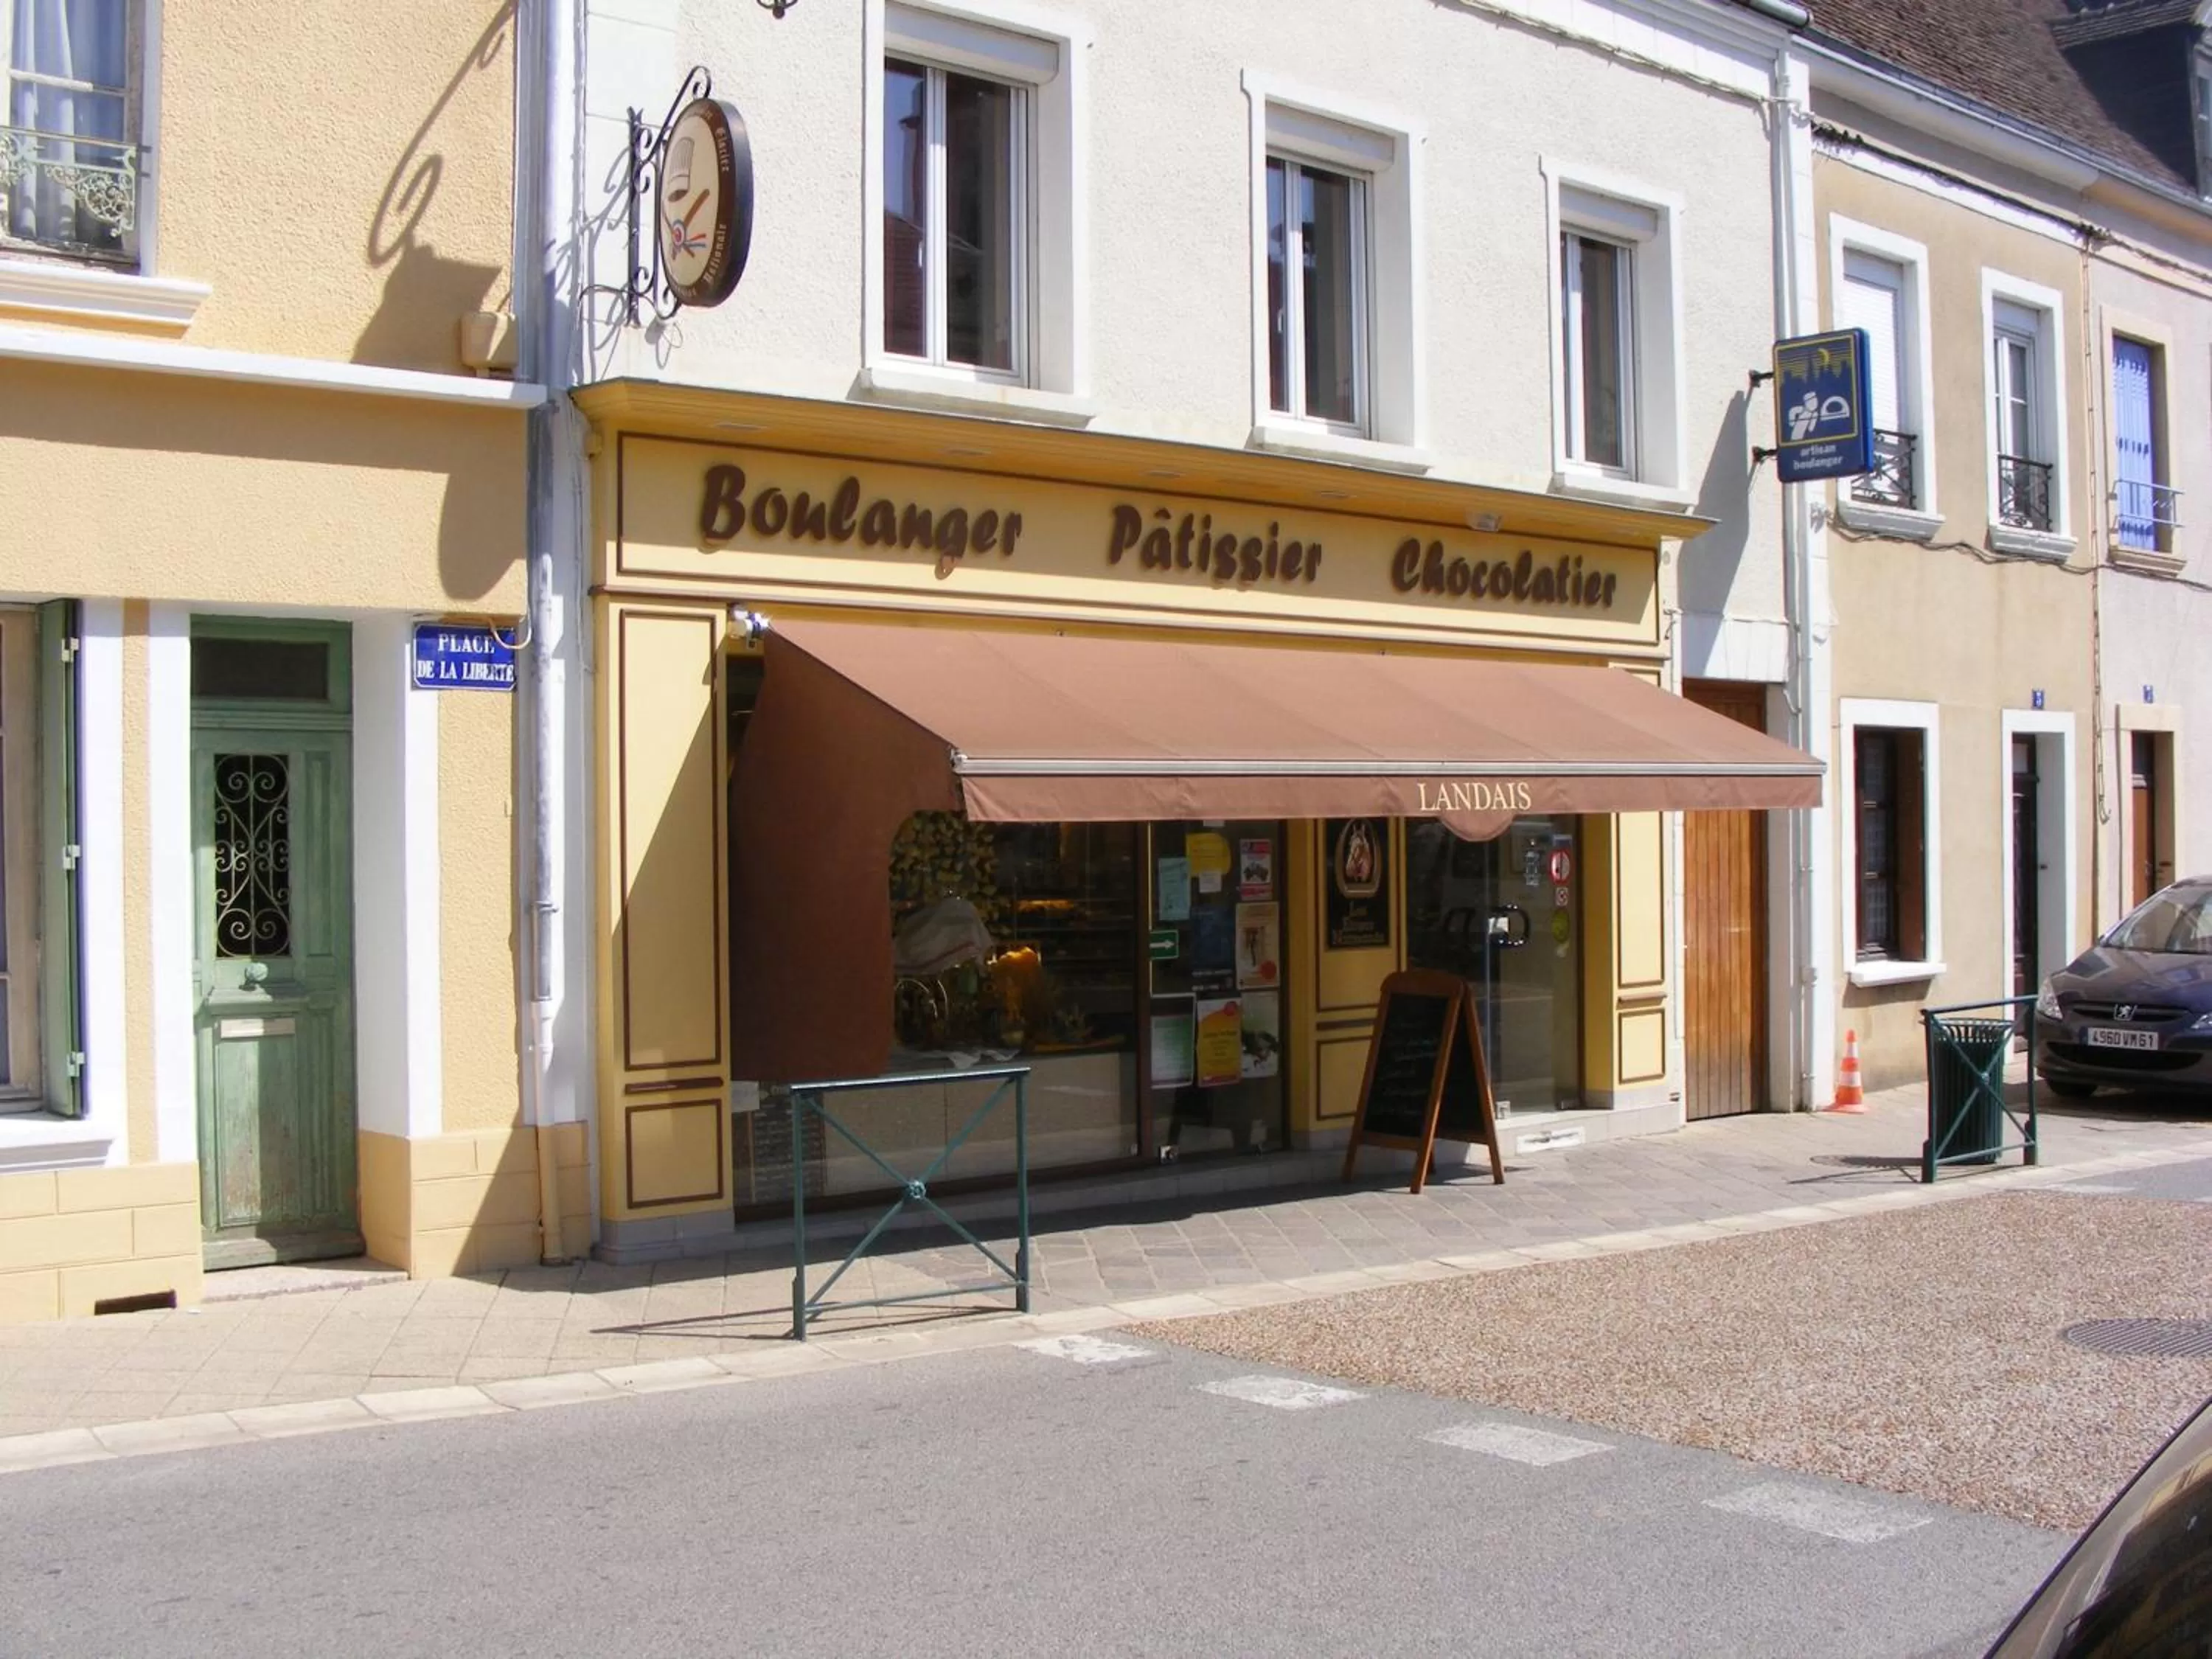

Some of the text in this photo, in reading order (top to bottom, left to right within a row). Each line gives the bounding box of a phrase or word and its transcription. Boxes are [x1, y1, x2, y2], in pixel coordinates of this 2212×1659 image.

[1800, 445, 1837, 456] artisan
[1792, 455, 1843, 470] boulanger
[700, 464, 1617, 608] Boulanger Pâtissier Chocolatier
[437, 633, 495, 654] PLACE
[417, 660, 435, 678] DE
[439, 660, 458, 679] LA
[1417, 782, 1531, 811] LANDAIS
[2139, 1034, 2154, 1047] 61
